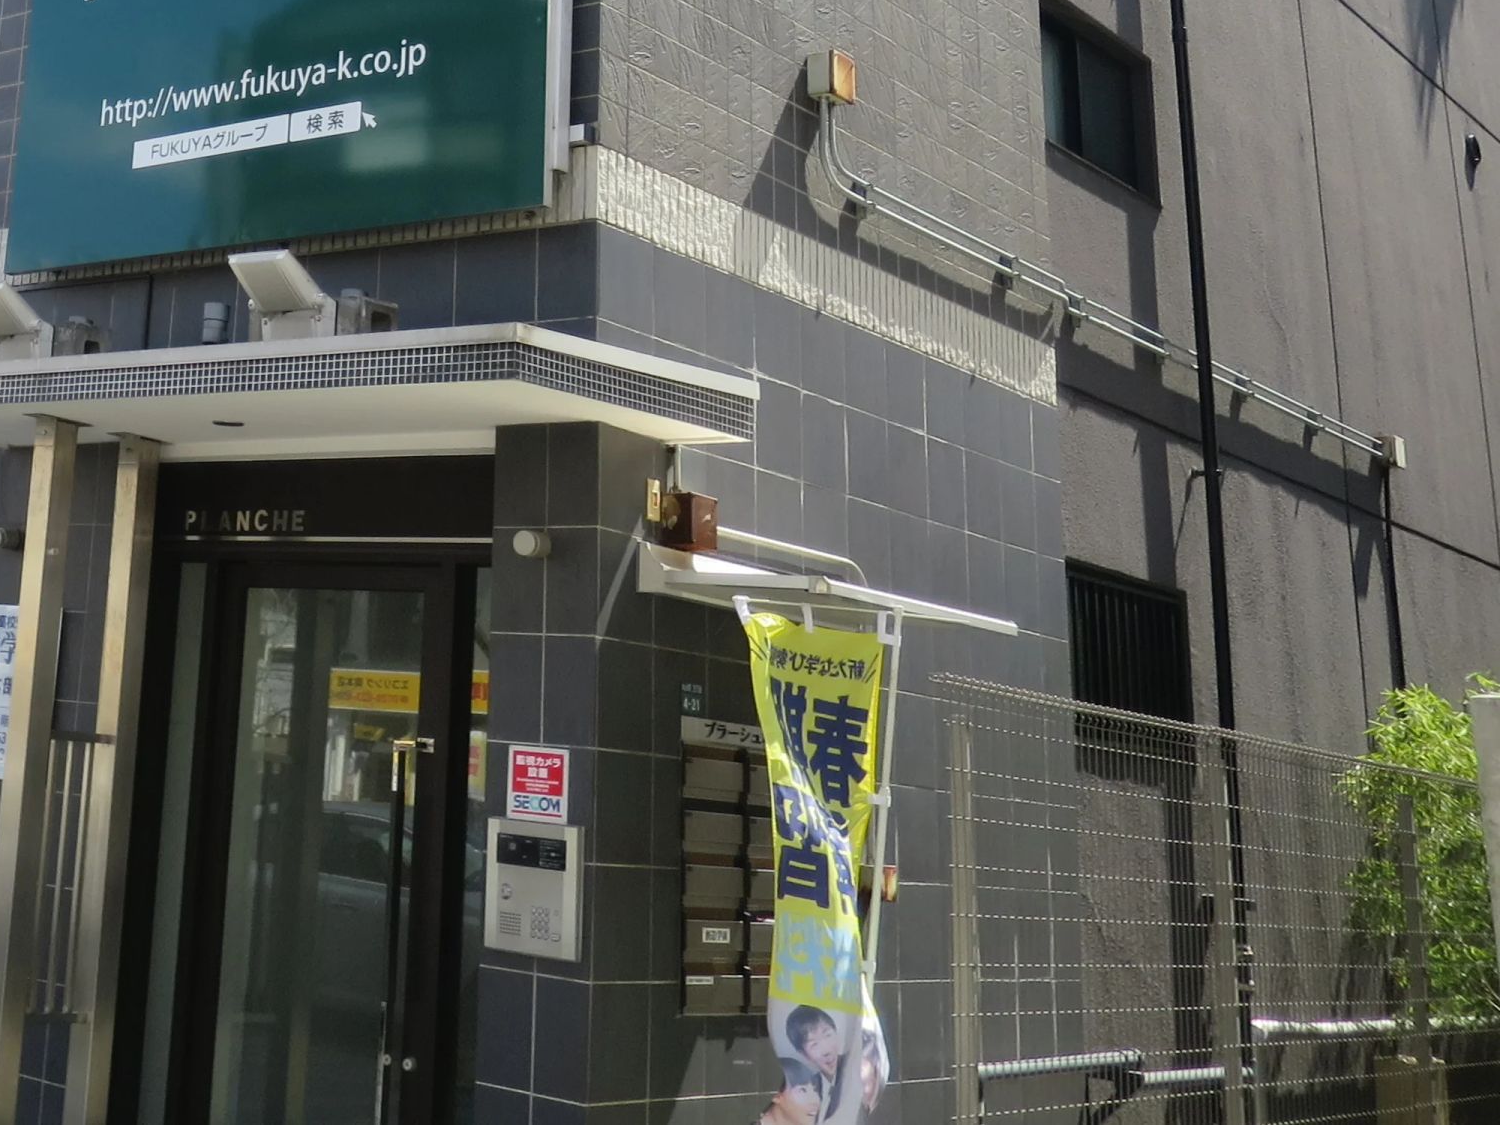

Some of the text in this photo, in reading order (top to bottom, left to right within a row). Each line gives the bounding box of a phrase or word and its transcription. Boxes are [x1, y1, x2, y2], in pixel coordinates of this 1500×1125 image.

[100, 39, 427, 128] http://www.fukuya-k.co.jp
[150, 123, 269, 161] FUKUYAグループ
[185, 510, 305, 532] PLANCHE
[514, 794, 560, 812] SECOM
